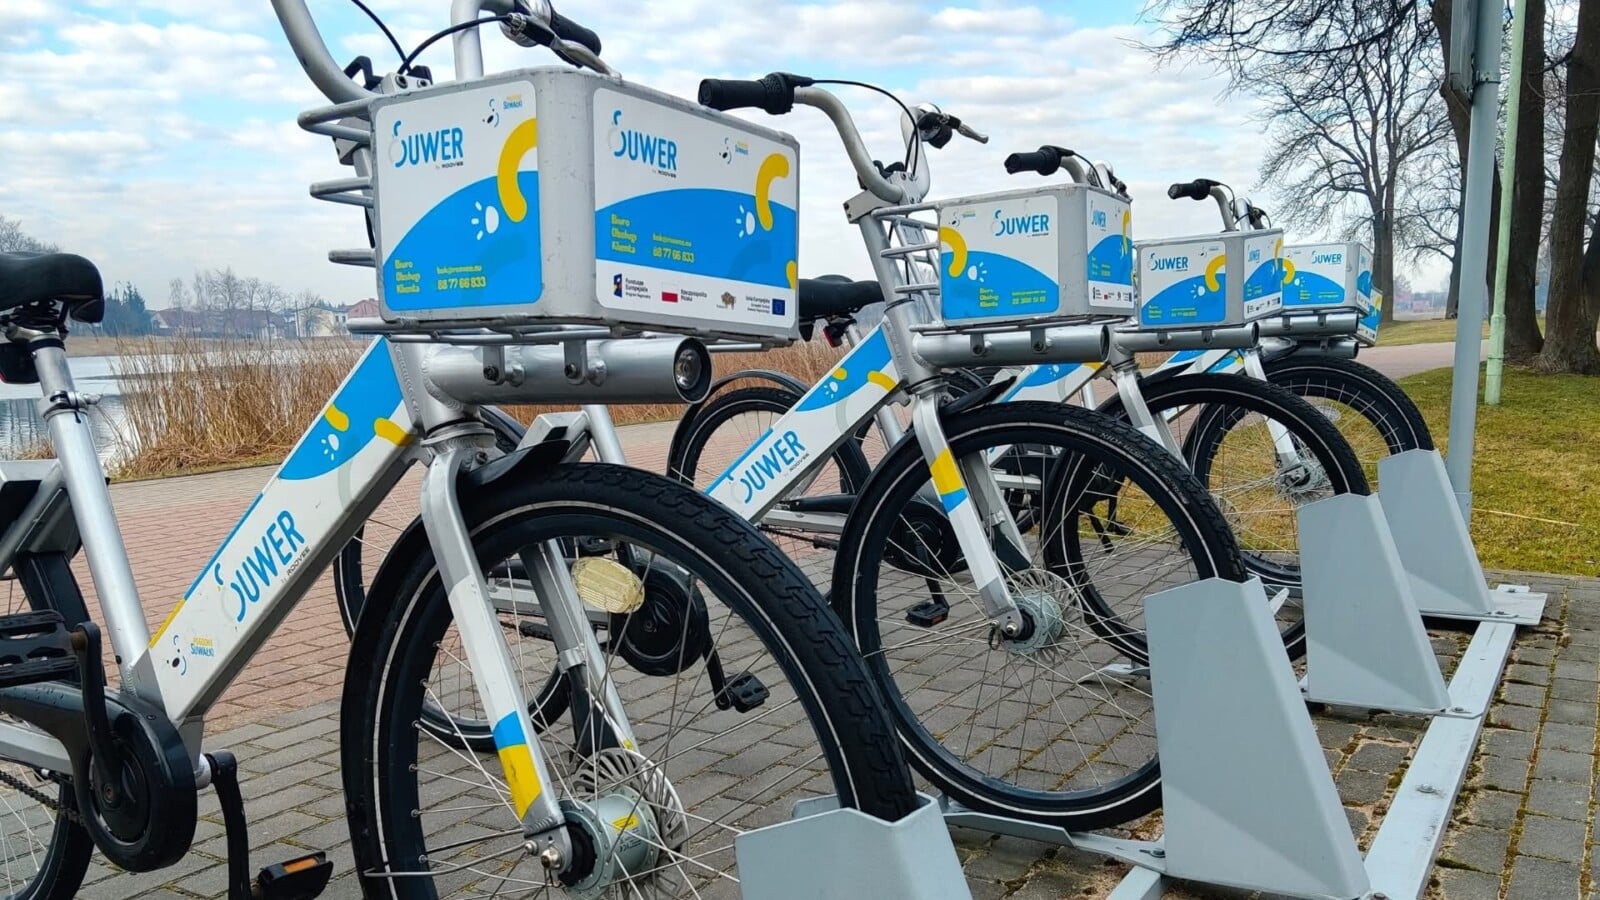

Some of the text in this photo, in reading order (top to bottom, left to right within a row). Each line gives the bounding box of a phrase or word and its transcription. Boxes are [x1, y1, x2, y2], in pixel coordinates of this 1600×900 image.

[390, 120, 464, 168] SUWER
[609, 110, 677, 170] SUWER
[992, 210, 1049, 237] SUWER
[1149, 253, 1188, 271] SUWER
[215, 510, 305, 623] SUWER
